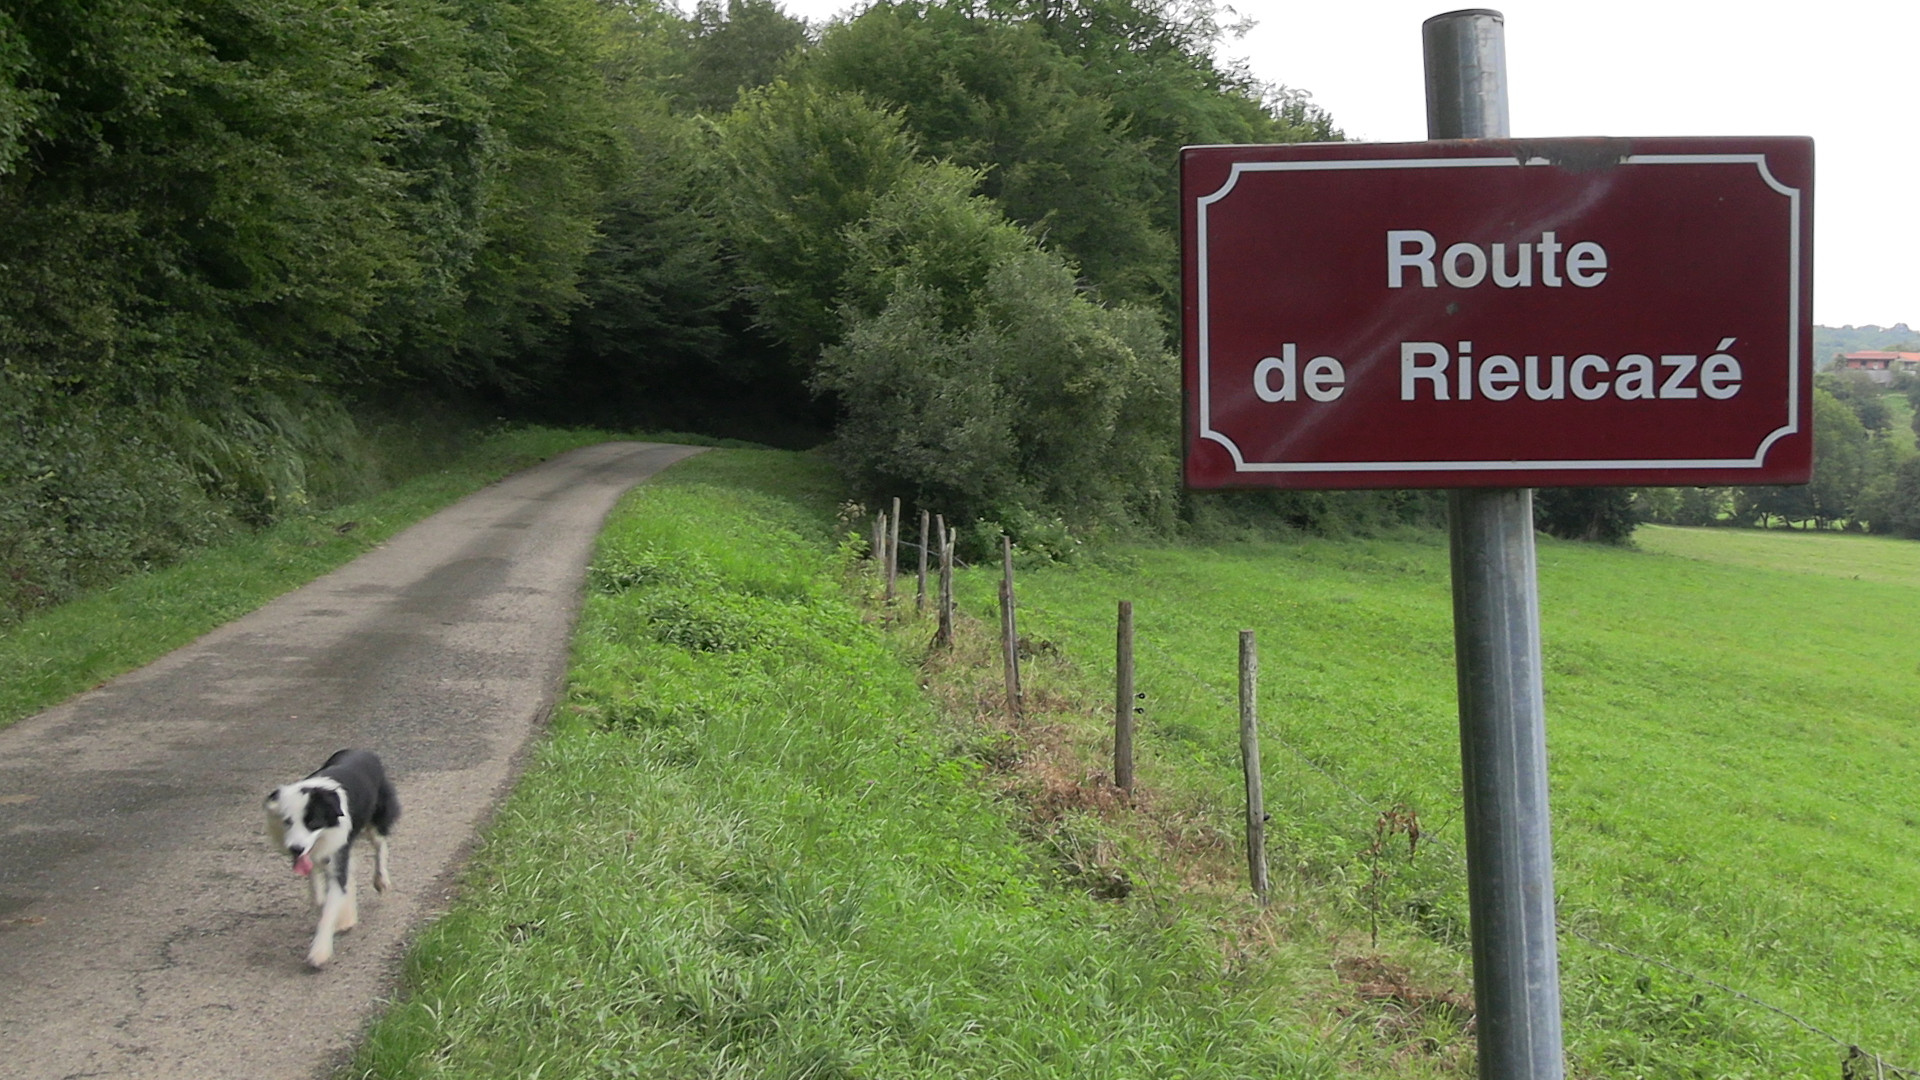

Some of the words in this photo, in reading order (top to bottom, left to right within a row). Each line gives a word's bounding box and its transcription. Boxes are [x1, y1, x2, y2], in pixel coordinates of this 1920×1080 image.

[1386, 230, 1608, 289] Route
[1252, 343, 1346, 403] de
[1400, 337, 1742, 402] Rieucazé
